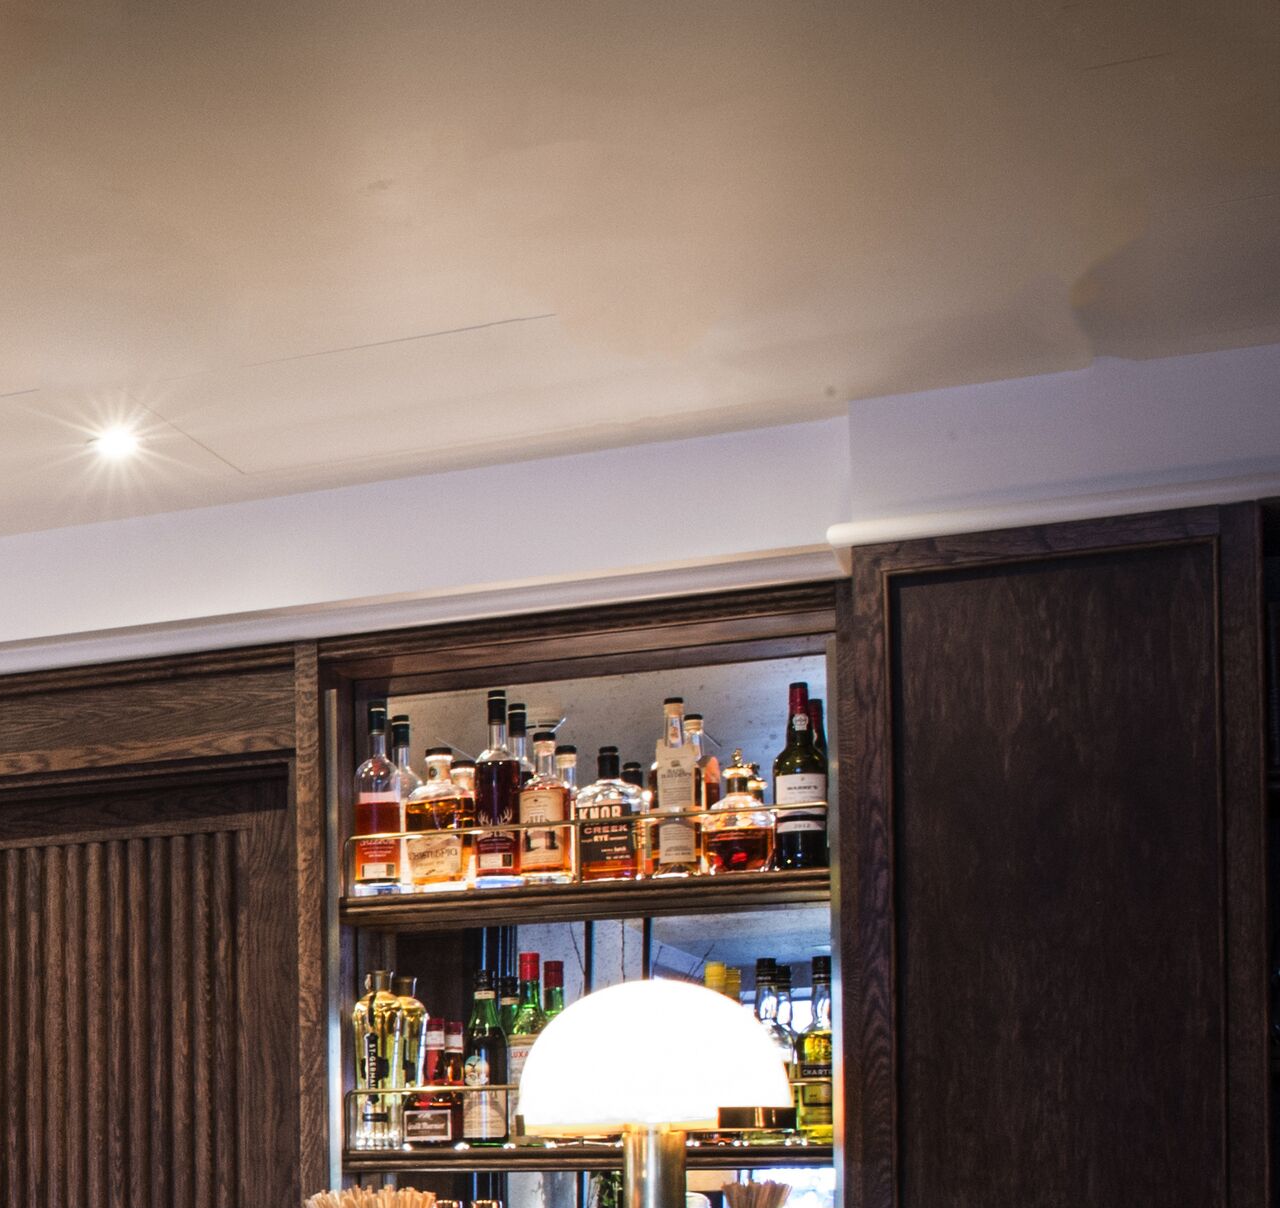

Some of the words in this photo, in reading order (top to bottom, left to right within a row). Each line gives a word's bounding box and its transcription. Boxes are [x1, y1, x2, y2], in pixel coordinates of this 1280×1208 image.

[579, 805, 623, 820] KNOB
[583, 824, 628, 835] CREEK
[368, 1043, 377, 1089] ST-GERMAI
